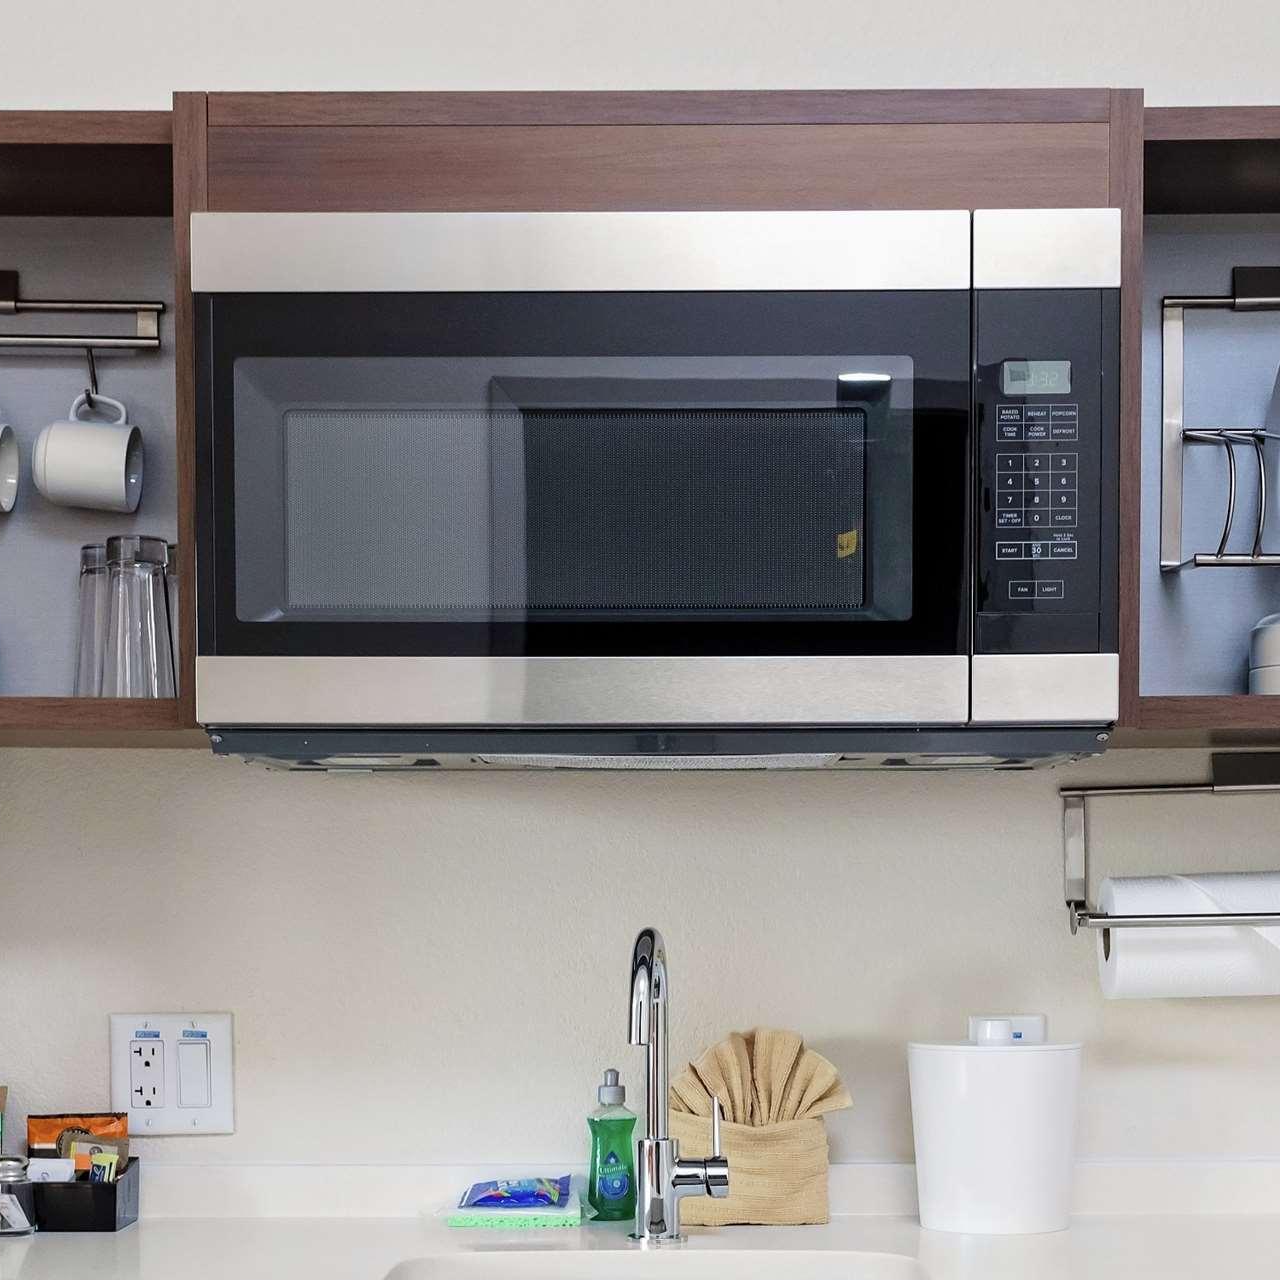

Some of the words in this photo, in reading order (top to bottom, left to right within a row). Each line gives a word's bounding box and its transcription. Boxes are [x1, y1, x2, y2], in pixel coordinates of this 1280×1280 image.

[1007, 459, 1012, 467] 1
[1061, 477, 1067, 485] 6
[1007, 496, 1013, 504] 7
